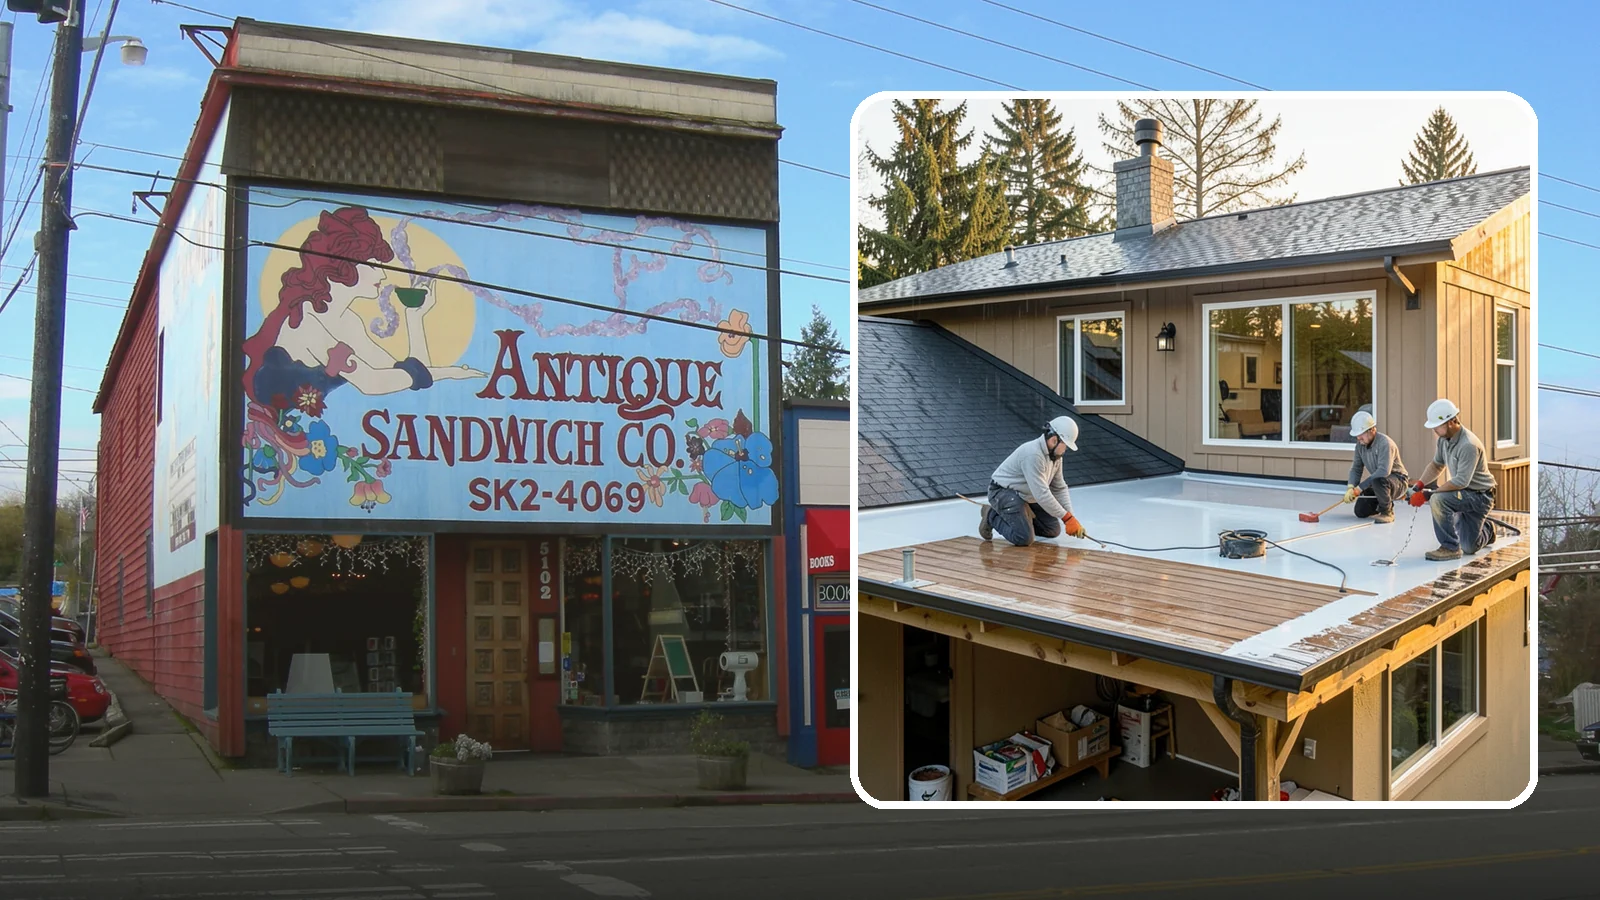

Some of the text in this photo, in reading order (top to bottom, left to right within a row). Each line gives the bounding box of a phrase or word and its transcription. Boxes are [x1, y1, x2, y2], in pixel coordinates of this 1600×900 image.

[475, 328, 723, 421] ANTIQUE
[361, 408, 685, 468] SANDWICH CO.
[468, 476, 645, 513] SK2-4069
[540, 541, 551, 600] 5102
[809, 555, 835, 569] BOOKS
